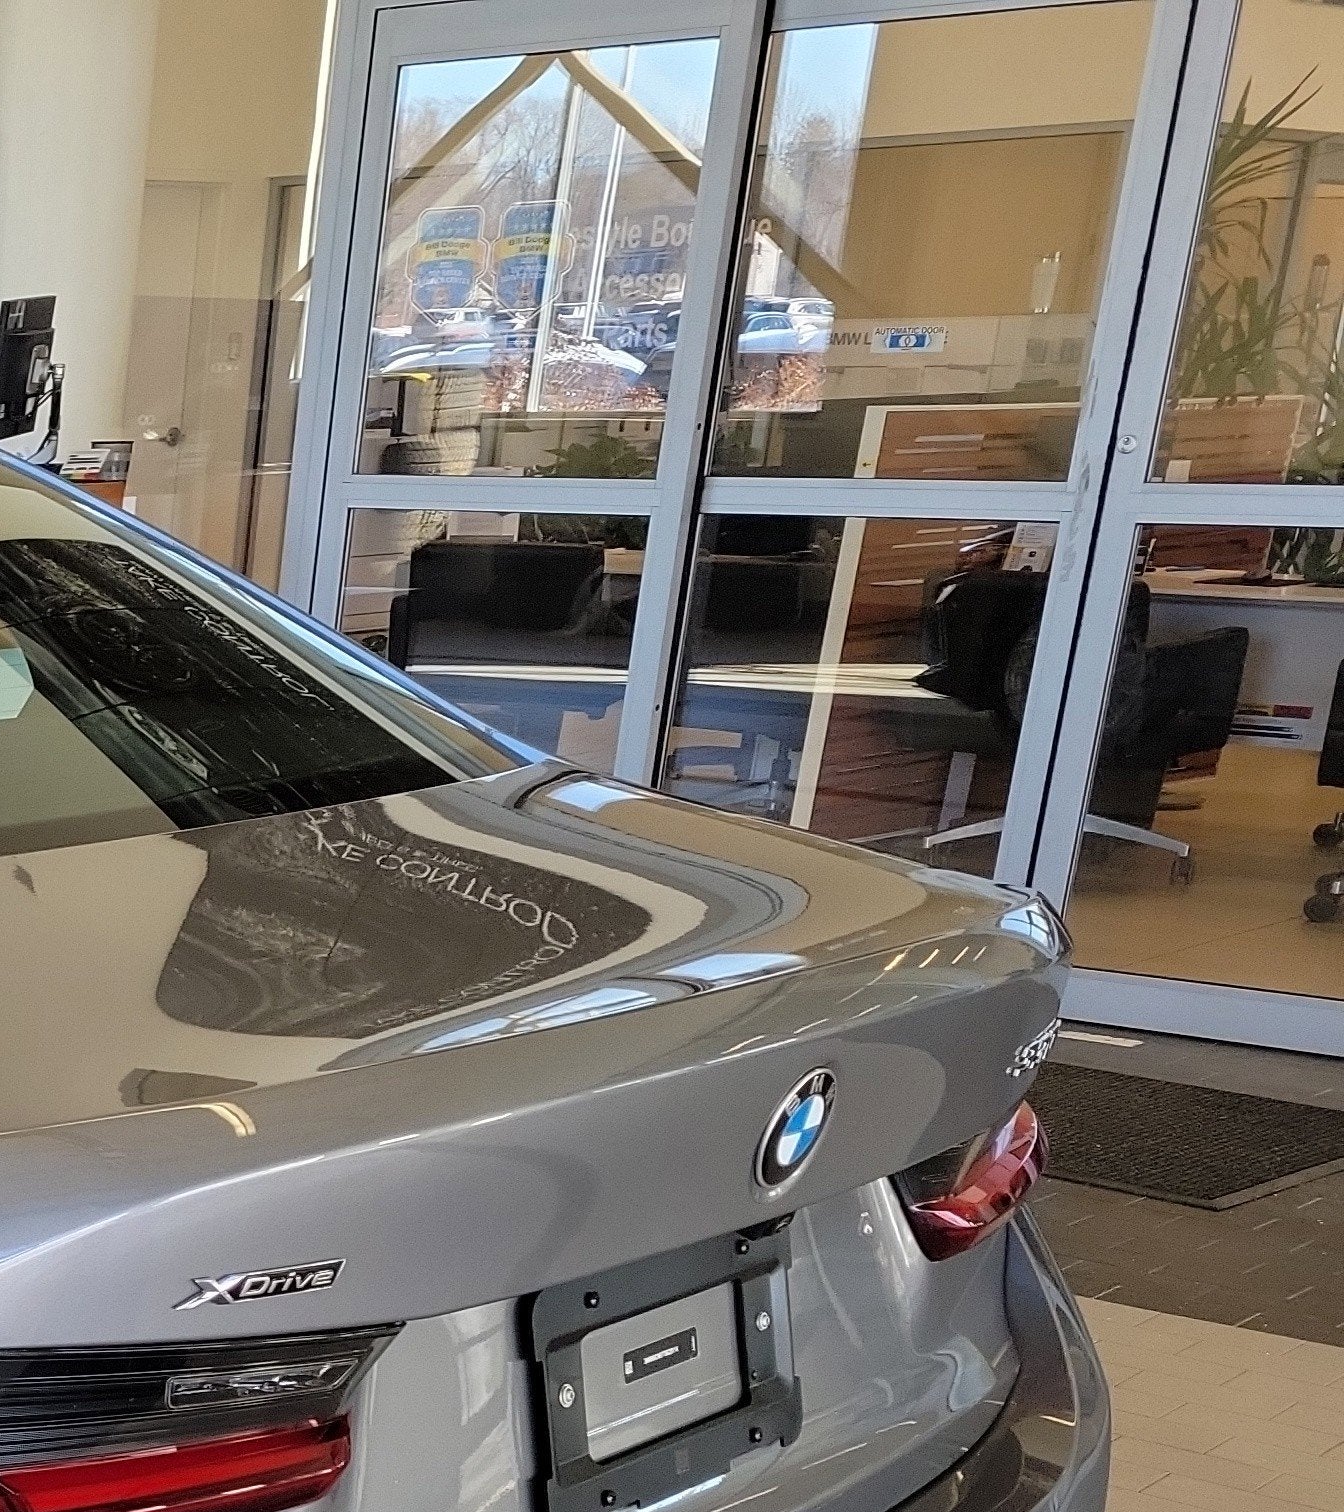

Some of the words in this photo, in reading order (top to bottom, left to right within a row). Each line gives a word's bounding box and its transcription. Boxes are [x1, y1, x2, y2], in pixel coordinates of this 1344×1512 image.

[525, 235, 550, 245] Dodg
[874, 326, 919, 336] AUTOMATIC
[921, 326, 945, 335] DOOR
